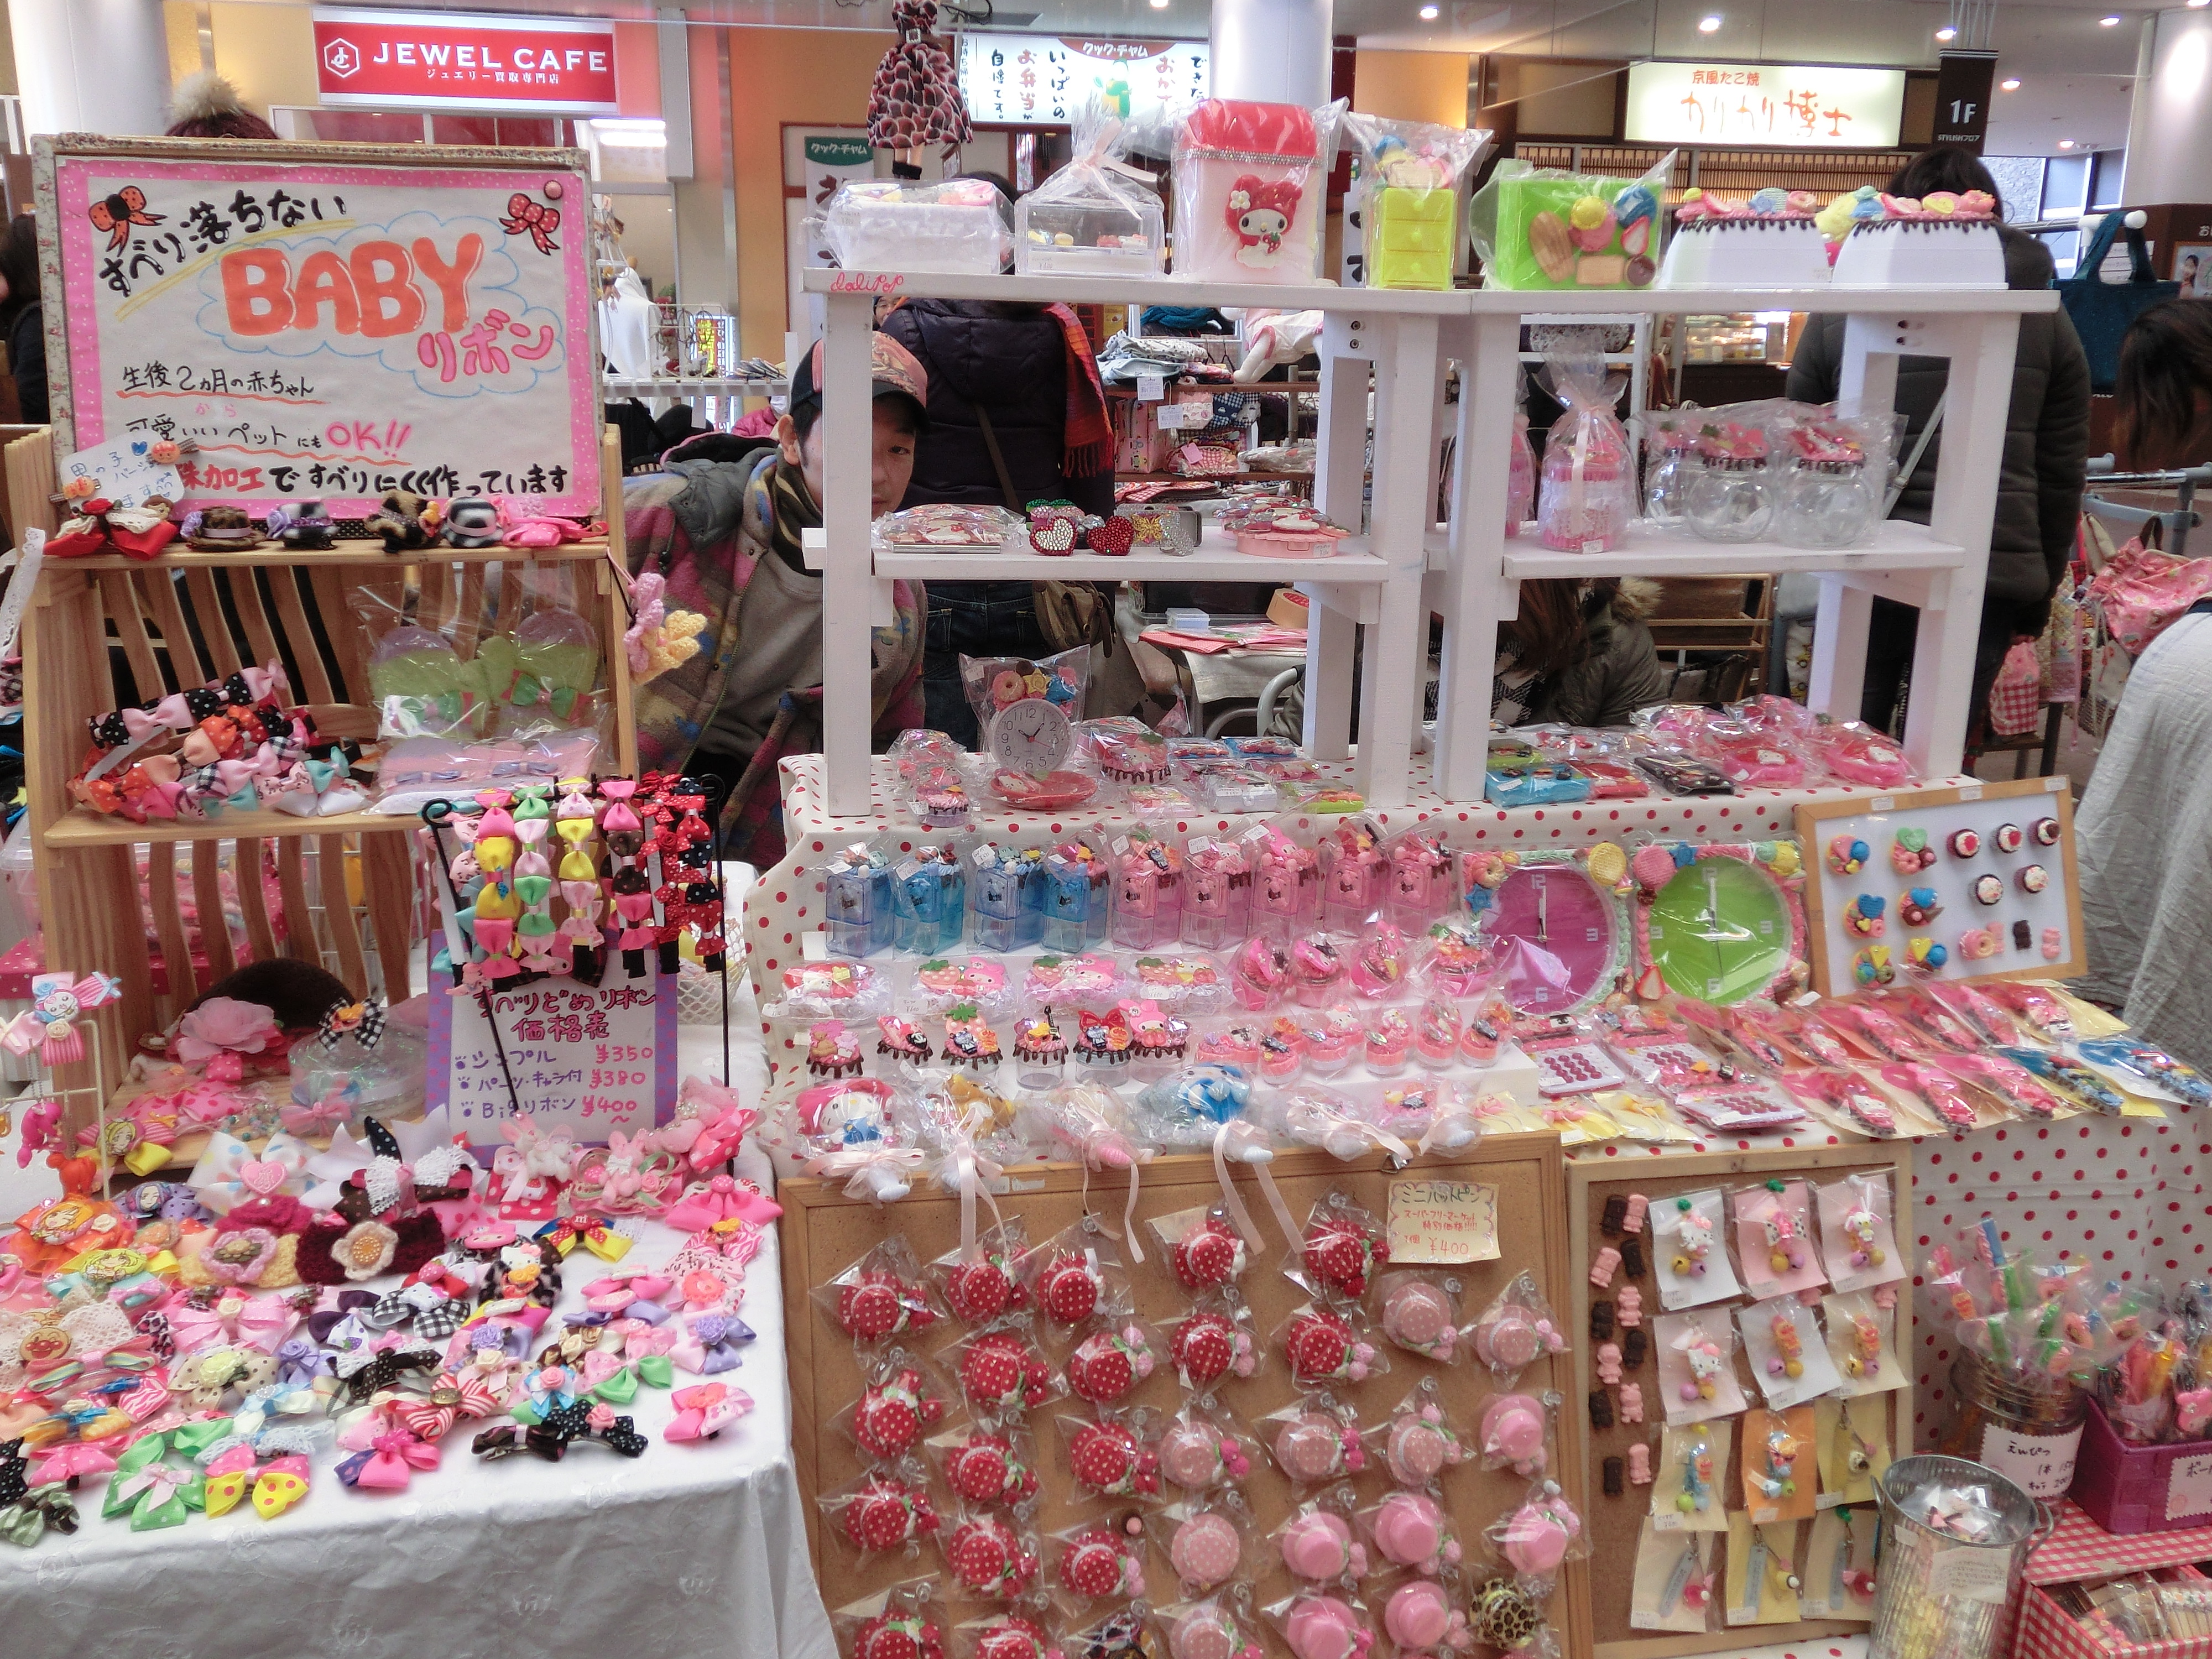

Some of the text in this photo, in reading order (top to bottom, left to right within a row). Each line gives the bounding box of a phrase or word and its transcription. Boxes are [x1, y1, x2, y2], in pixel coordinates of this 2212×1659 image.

[373, 42, 607, 71] JEWEL CAFE
[427, 69, 560, 84] ジュエリー買取専門店
[1018, 49, 1037, 120] お弁当が
[1692, 70, 1761, 86] 京風たこ焼
[1050, 51, 1071, 119] いっぱいの
[1950, 100, 1976, 123] 1F
[99, 189, 347, 297] すべり落ちない
[222, 233, 483, 337] BABY
[417, 308, 554, 382] リボン
[195, 402, 237, 418] から
[1026, 708, 1036, 718] 12
[1003, 721, 1013, 730] 10
[1050, 722, 1057, 731] 2
[1001, 733, 1009, 743] 9
[1004, 746, 1011, 756] 8
[1013, 757, 1020, 765] 7
[1025, 760, 1033, 768] 6
[1039, 757, 1046, 766] 5
[1532, 874, 1546, 889] 12
[1587, 928, 1598, 941] 3
[1535, 987, 1548, 1002] 6
[511, 1011, 610, 1042] 価格表
[595, 1044, 654, 1065] ¥350
[589, 1069, 646, 1090] ¥380
[581, 1094, 637, 1118] ¥400
[1428, 1237, 1469, 1255] ¥400
